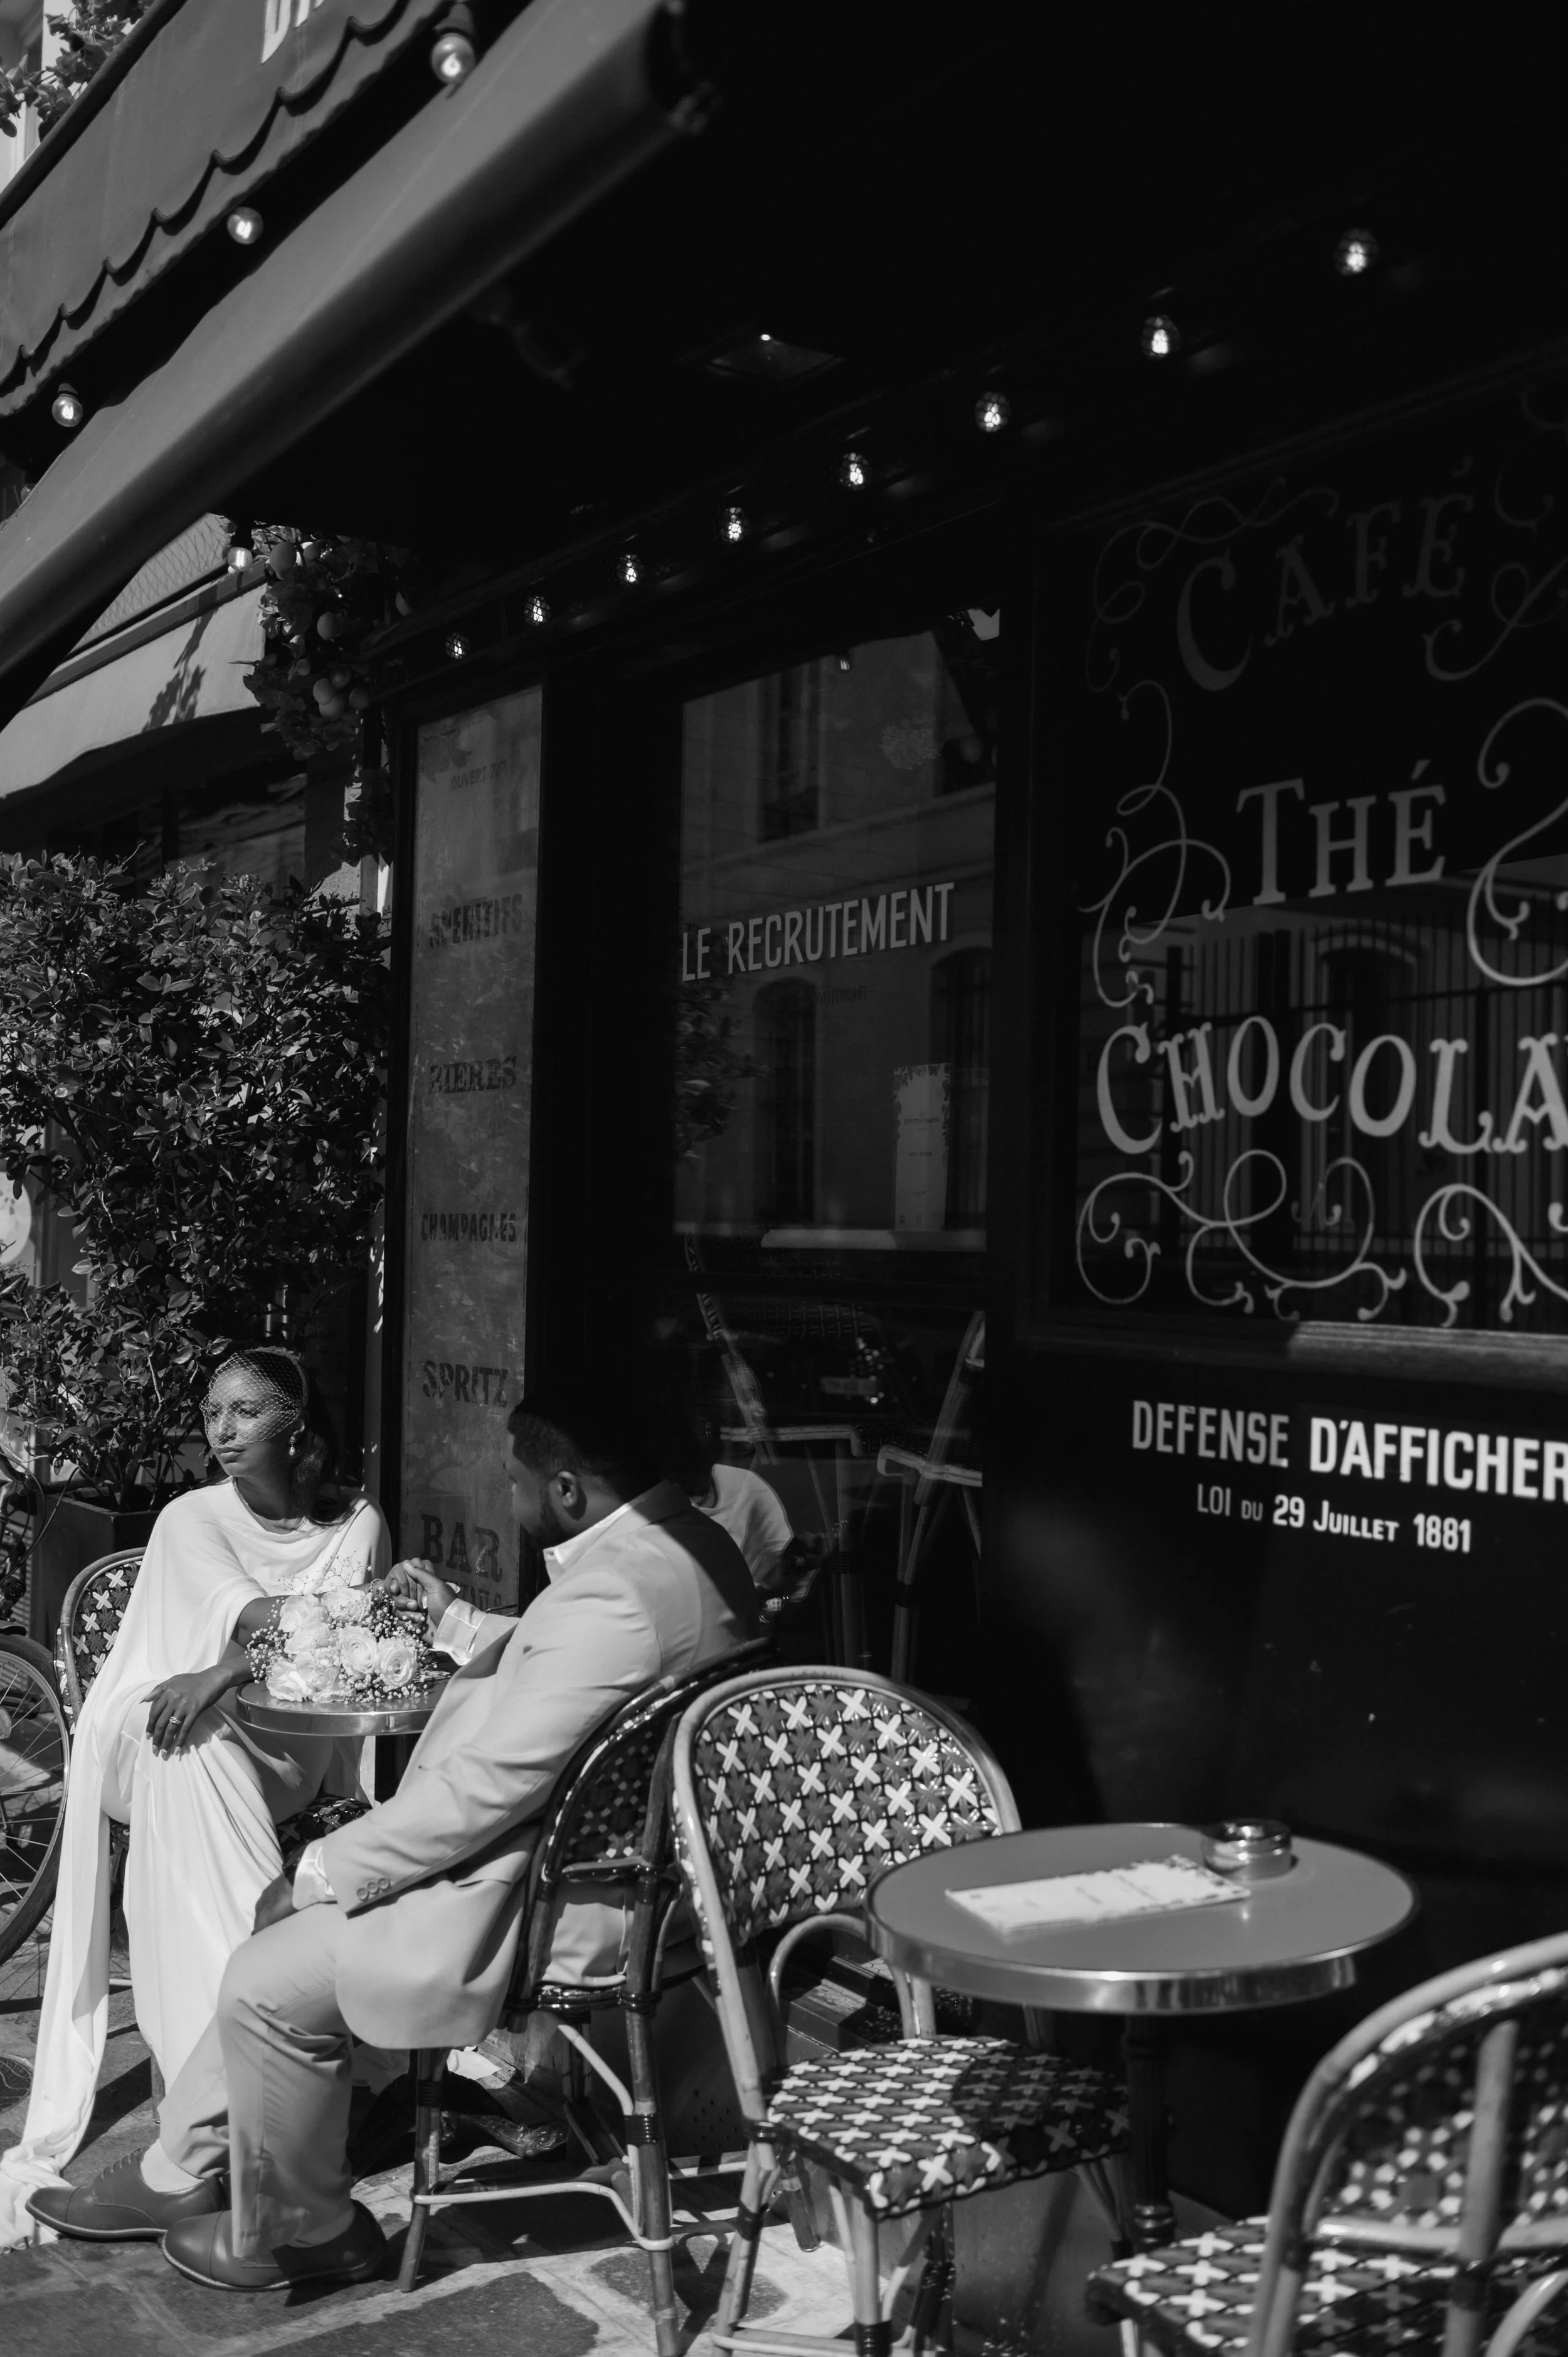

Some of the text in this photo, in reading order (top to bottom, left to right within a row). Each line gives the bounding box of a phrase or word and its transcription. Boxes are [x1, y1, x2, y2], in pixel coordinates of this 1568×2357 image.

[1177, 455, 1475, 691] CAFÉ
[1236, 758, 1447, 906] THÉ
[682, 881, 955, 982] LE RECRUTEMENT
[1096, 1015, 1568, 1155] CHOCOLA
[423, 1359, 508, 1408] SPRITZ
[1131, 1399, 1290, 1469] DEFENSE
[421, 1513, 502, 1583] BAR
[1197, 1482, 1472, 1555] LOI DU 29 JUILLET 1881
